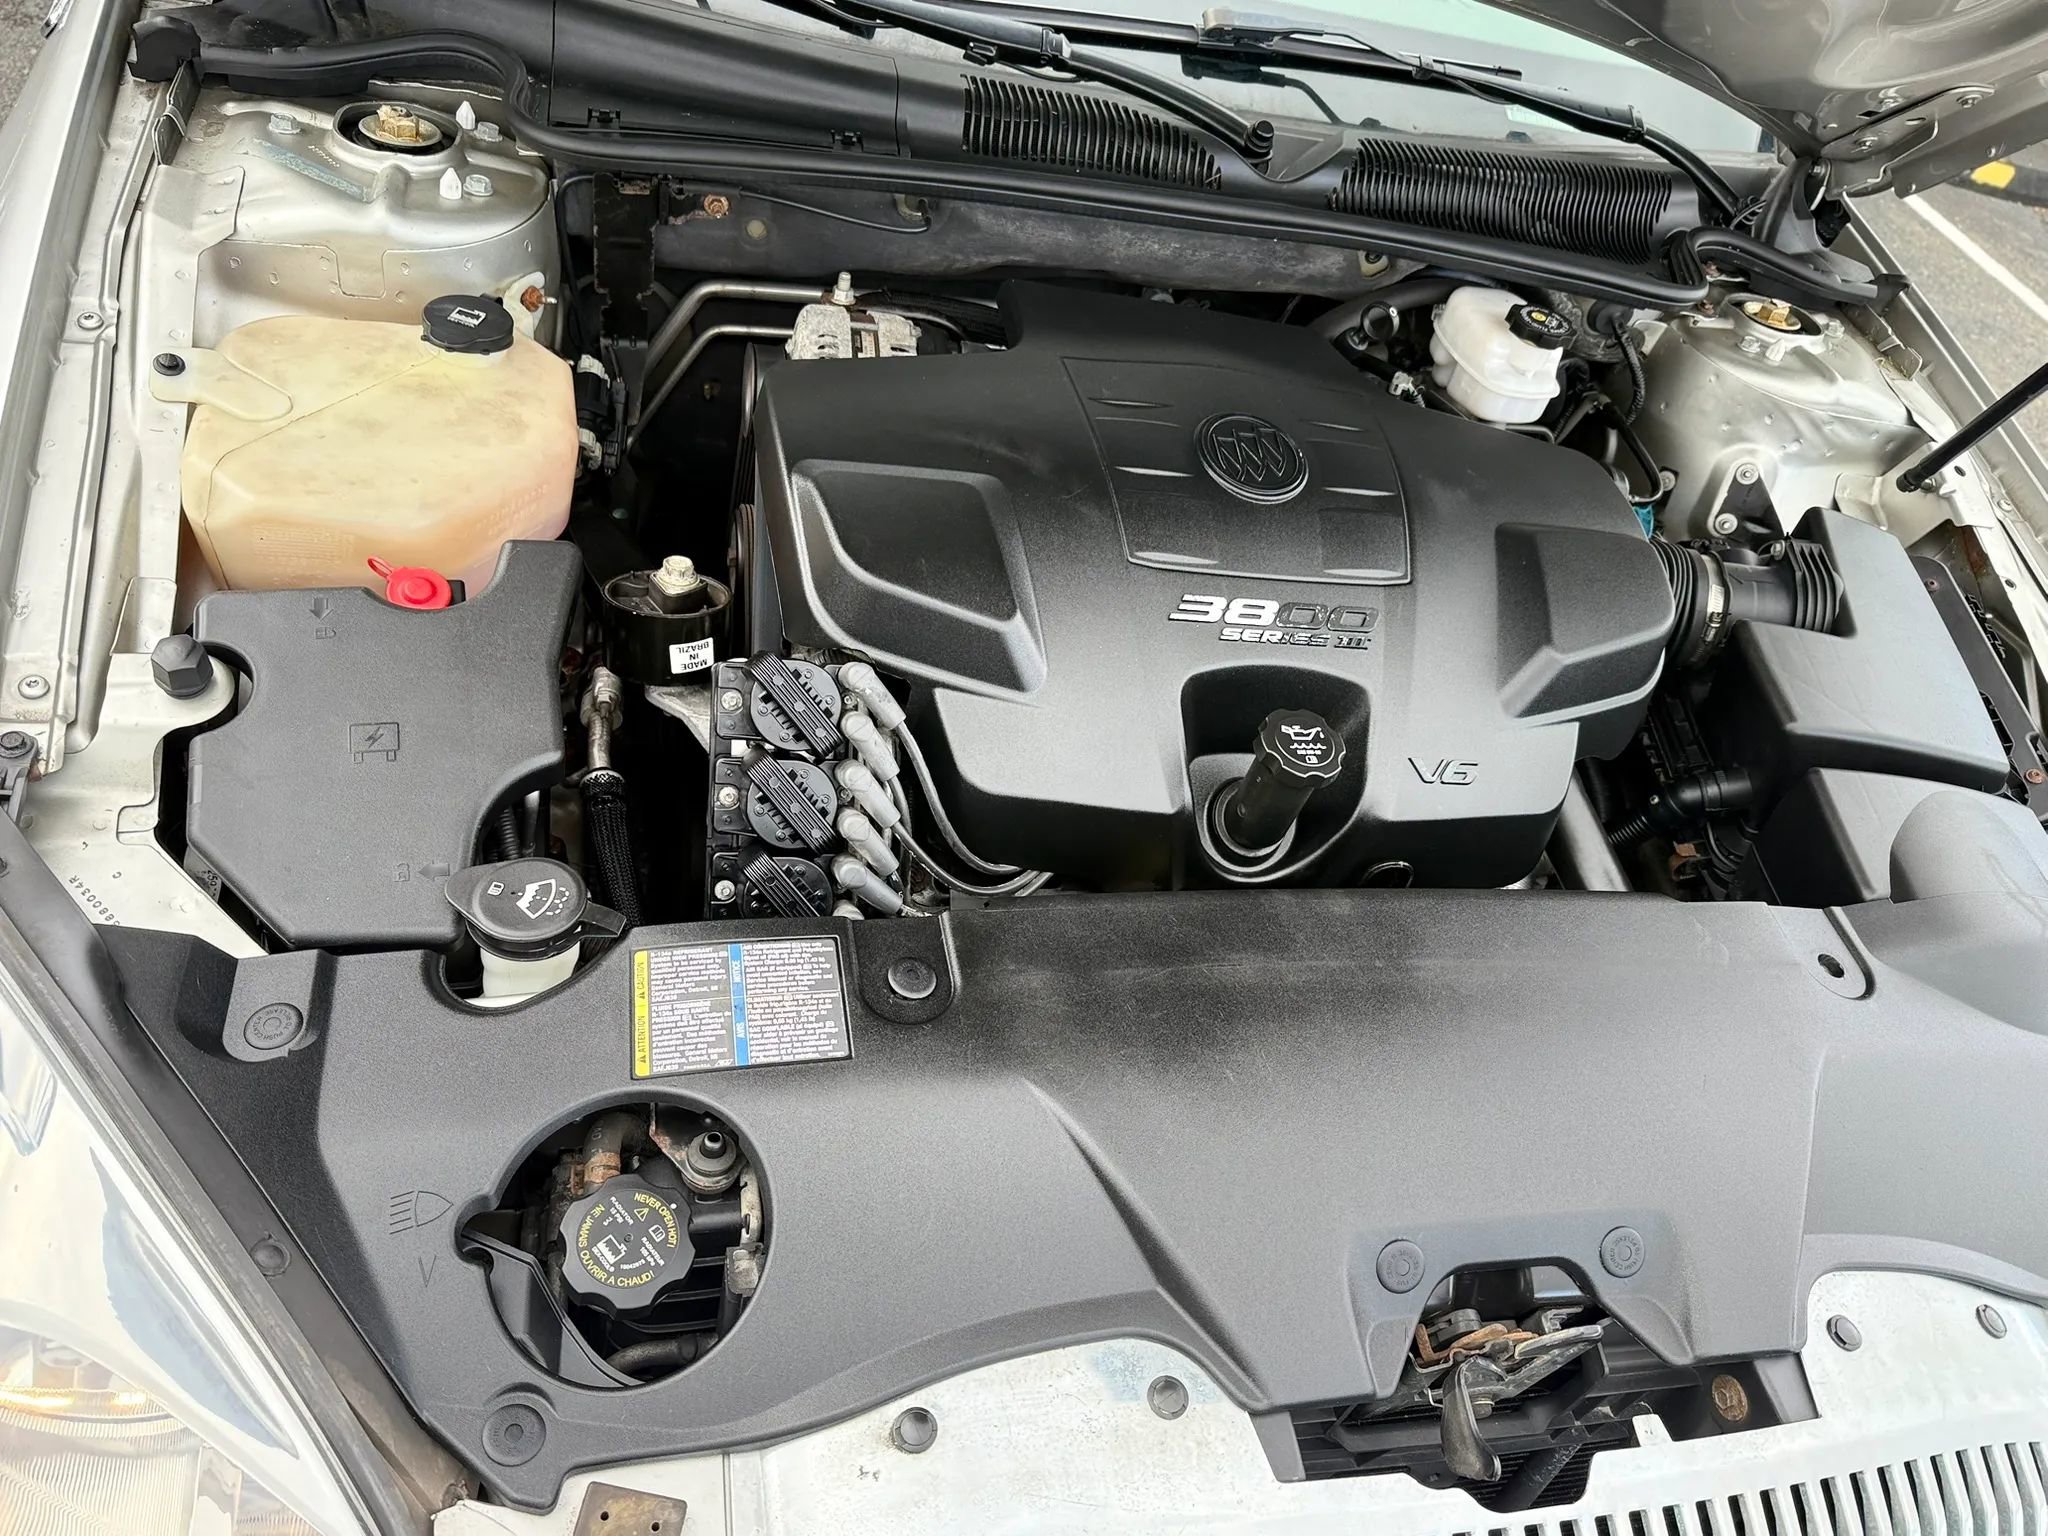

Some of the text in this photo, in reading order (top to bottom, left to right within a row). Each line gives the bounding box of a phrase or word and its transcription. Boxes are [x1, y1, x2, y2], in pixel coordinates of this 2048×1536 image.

[1169, 594, 1379, 633] 3800
[675, 641, 710, 653] BRAZIL
[1219, 627, 1331, 647] SERIES
[681, 659, 708, 671] MADE
[689, 652, 699, 660] IN
[1407, 757, 1479, 785] V6
[637, 962, 645, 990] CAUTION
[732, 960, 741, 983] NOTICE
[637, 1015, 645, 1053] ATTENTION
[591, 1203, 605, 1218] NE
[610, 1196, 634, 1226] RADIATOR
[634, 1192, 677, 1248] NEVER OPEN HOT!
[578, 1215, 594, 1248] JAMAIS
[581, 1250, 607, 1281] OUVRIR
[641, 1236, 665, 1267] RADIATEUR
[617, 1269, 655, 1287] CHAUD!
